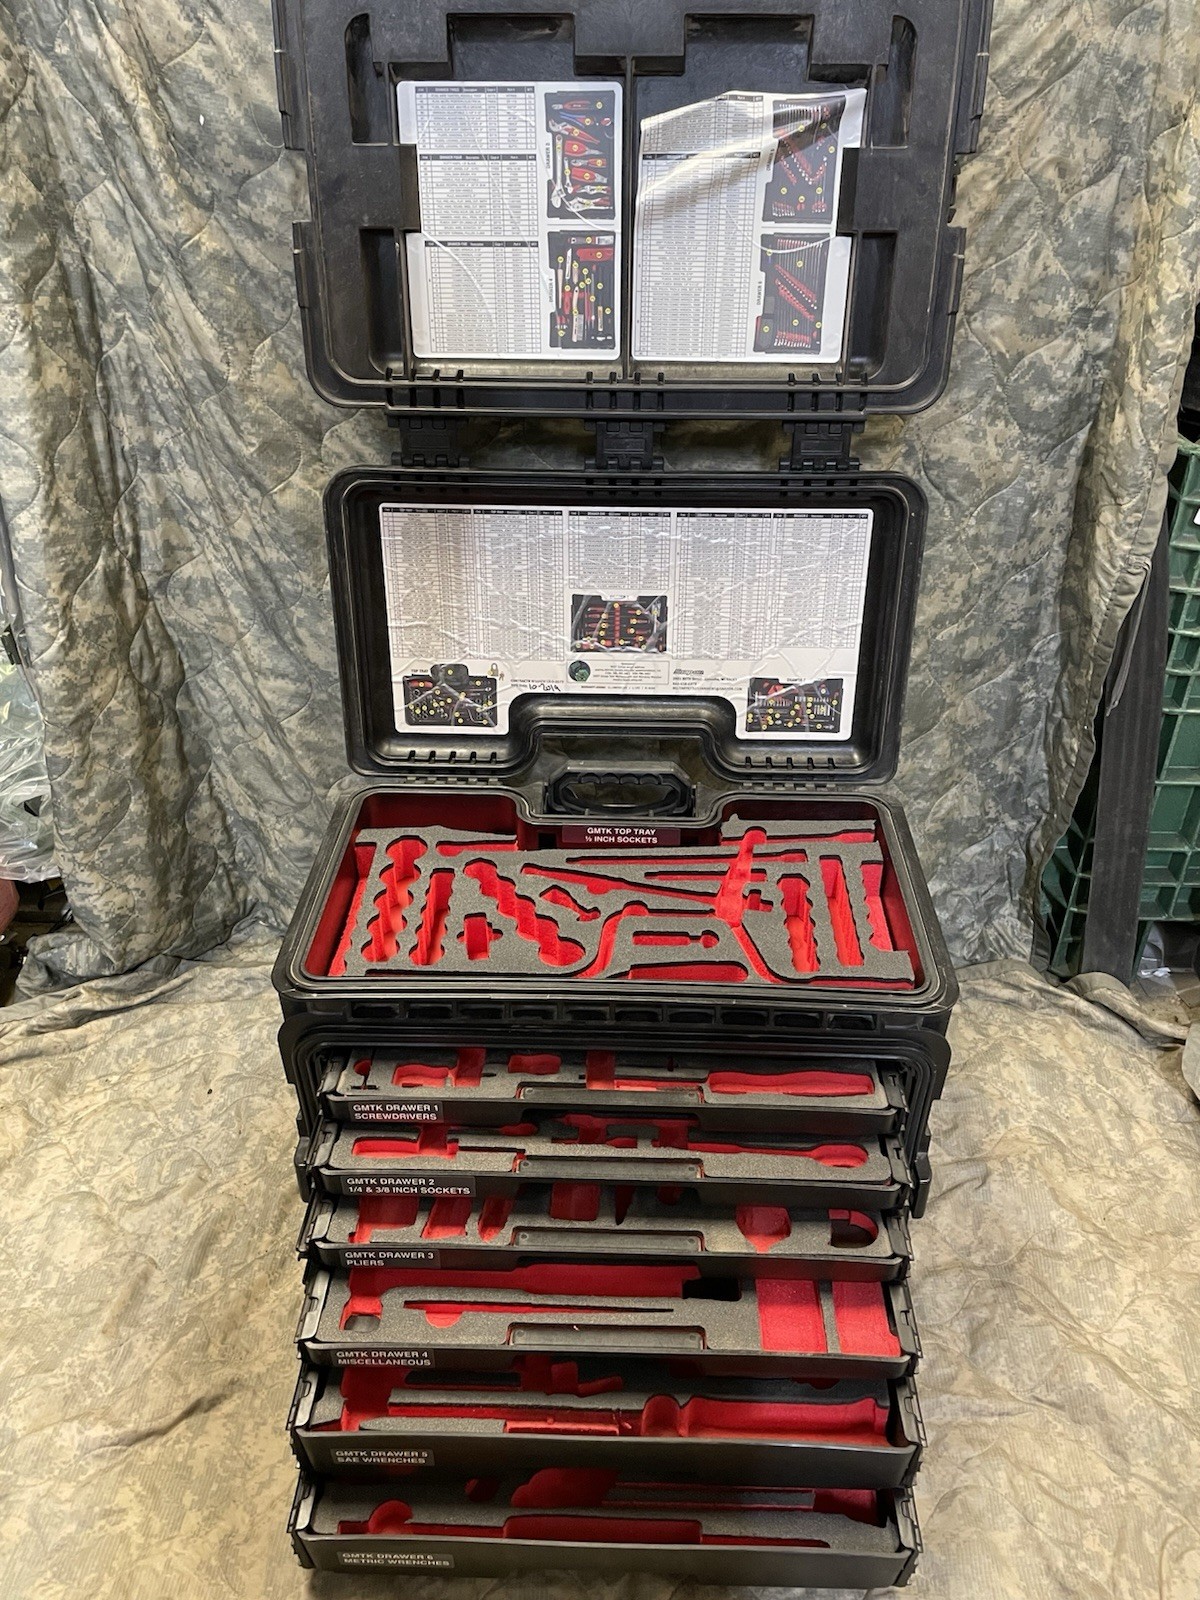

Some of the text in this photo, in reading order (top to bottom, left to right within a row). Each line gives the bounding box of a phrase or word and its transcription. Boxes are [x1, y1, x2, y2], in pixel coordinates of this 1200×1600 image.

[587, 827, 612, 835] GMTK
[634, 828, 656, 836] TRAY
[617, 836, 658, 844] SOCKETS
[353, 1104, 383, 1112] GMTK
[386, 1104, 431, 1112] DRAWER
[355, 1113, 437, 1121] SCREWDRIVERS
[380, 1178, 425, 1186] DRAWER
[429, 1178, 435, 1186] 2
[366, 1186, 373, 1194] &
[420, 1187, 471, 1195] SOCKETS
[345, 1251, 376, 1259] GMTK
[338, 1358, 431, 1366] MISCELLANEOUS
